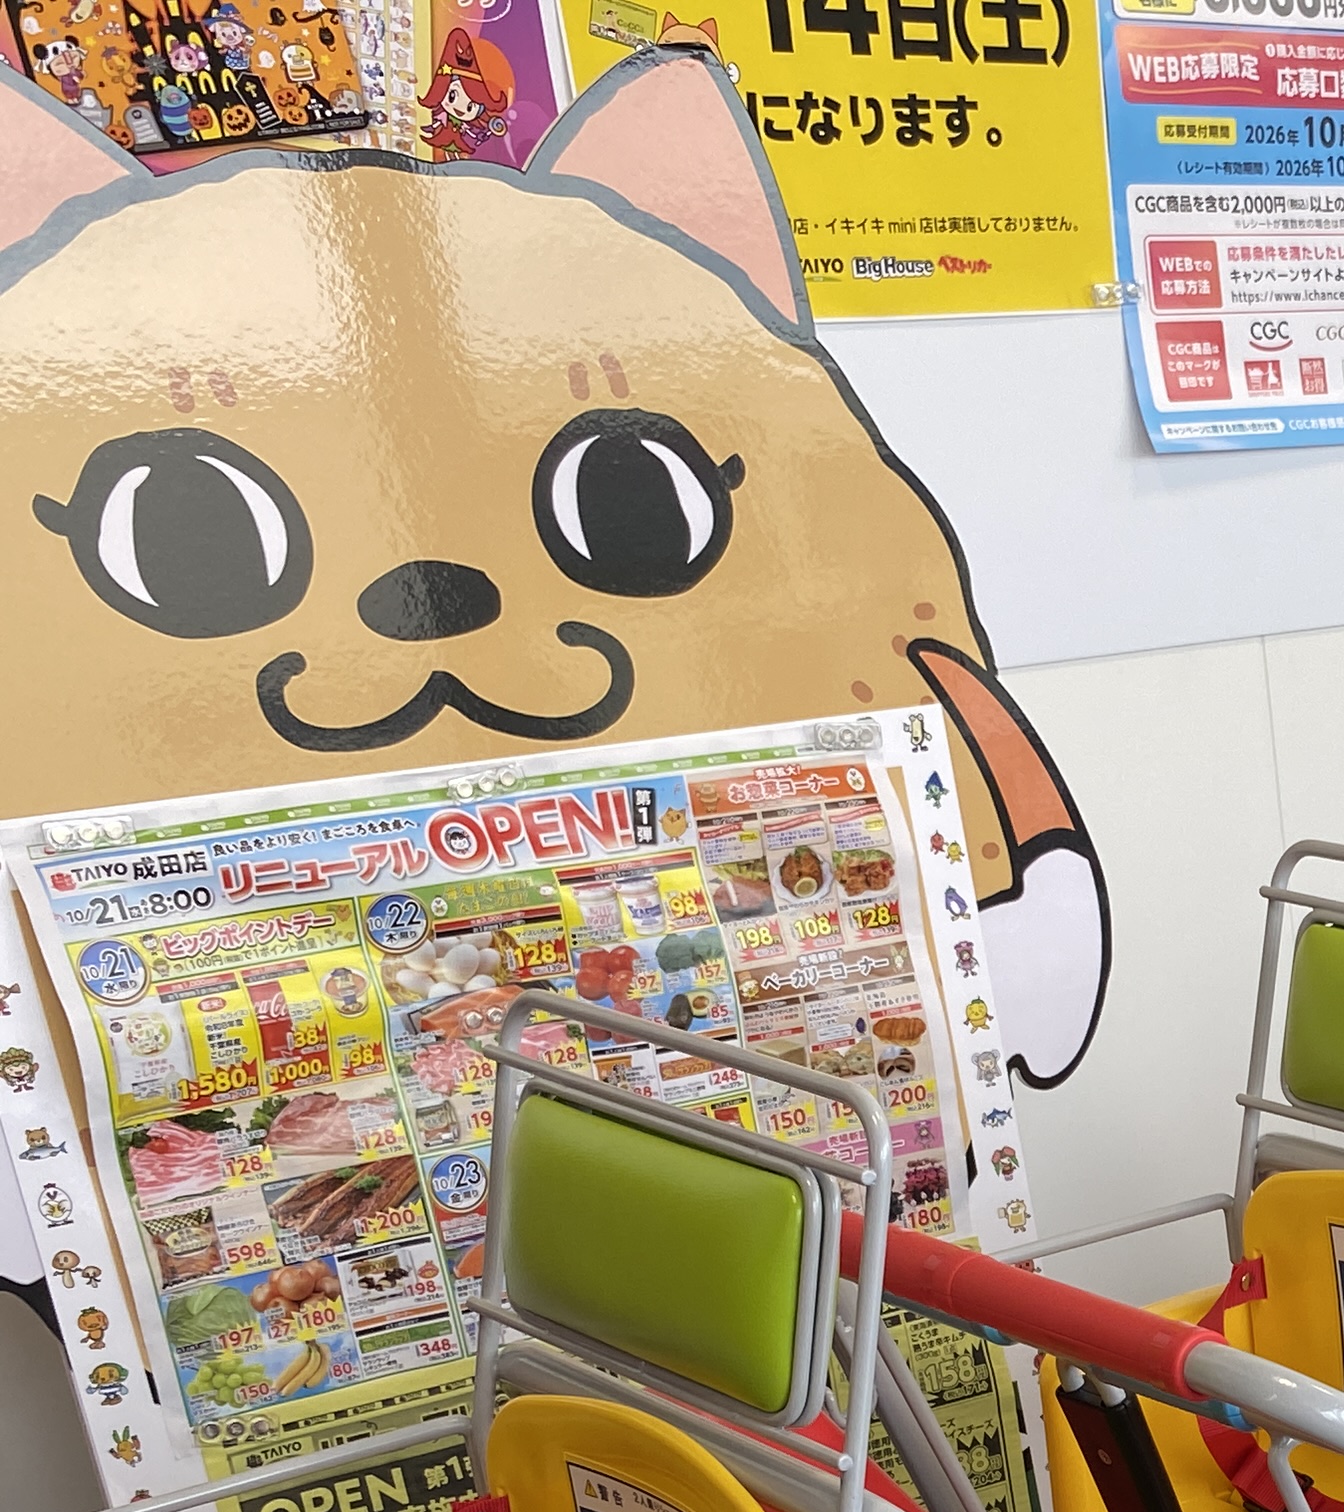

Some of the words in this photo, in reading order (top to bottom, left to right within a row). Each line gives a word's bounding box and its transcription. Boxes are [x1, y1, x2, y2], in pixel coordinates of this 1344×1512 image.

[1127, 52, 1261, 84] WEB応募限定
[747, 91, 1003, 148] になります。
[1159, 256, 1213, 273] WEBでの
[1161, 279, 1212, 297] 応募方法
[1250, 321, 1290, 341] CGC
[219, 838, 428, 901] リニューアル
[427, 789, 635, 868] OPEN!
[70, 863, 128, 883] TAIYO
[132, 850, 209, 883] 成田店
[261, 1441, 303, 1461] TAIYO
